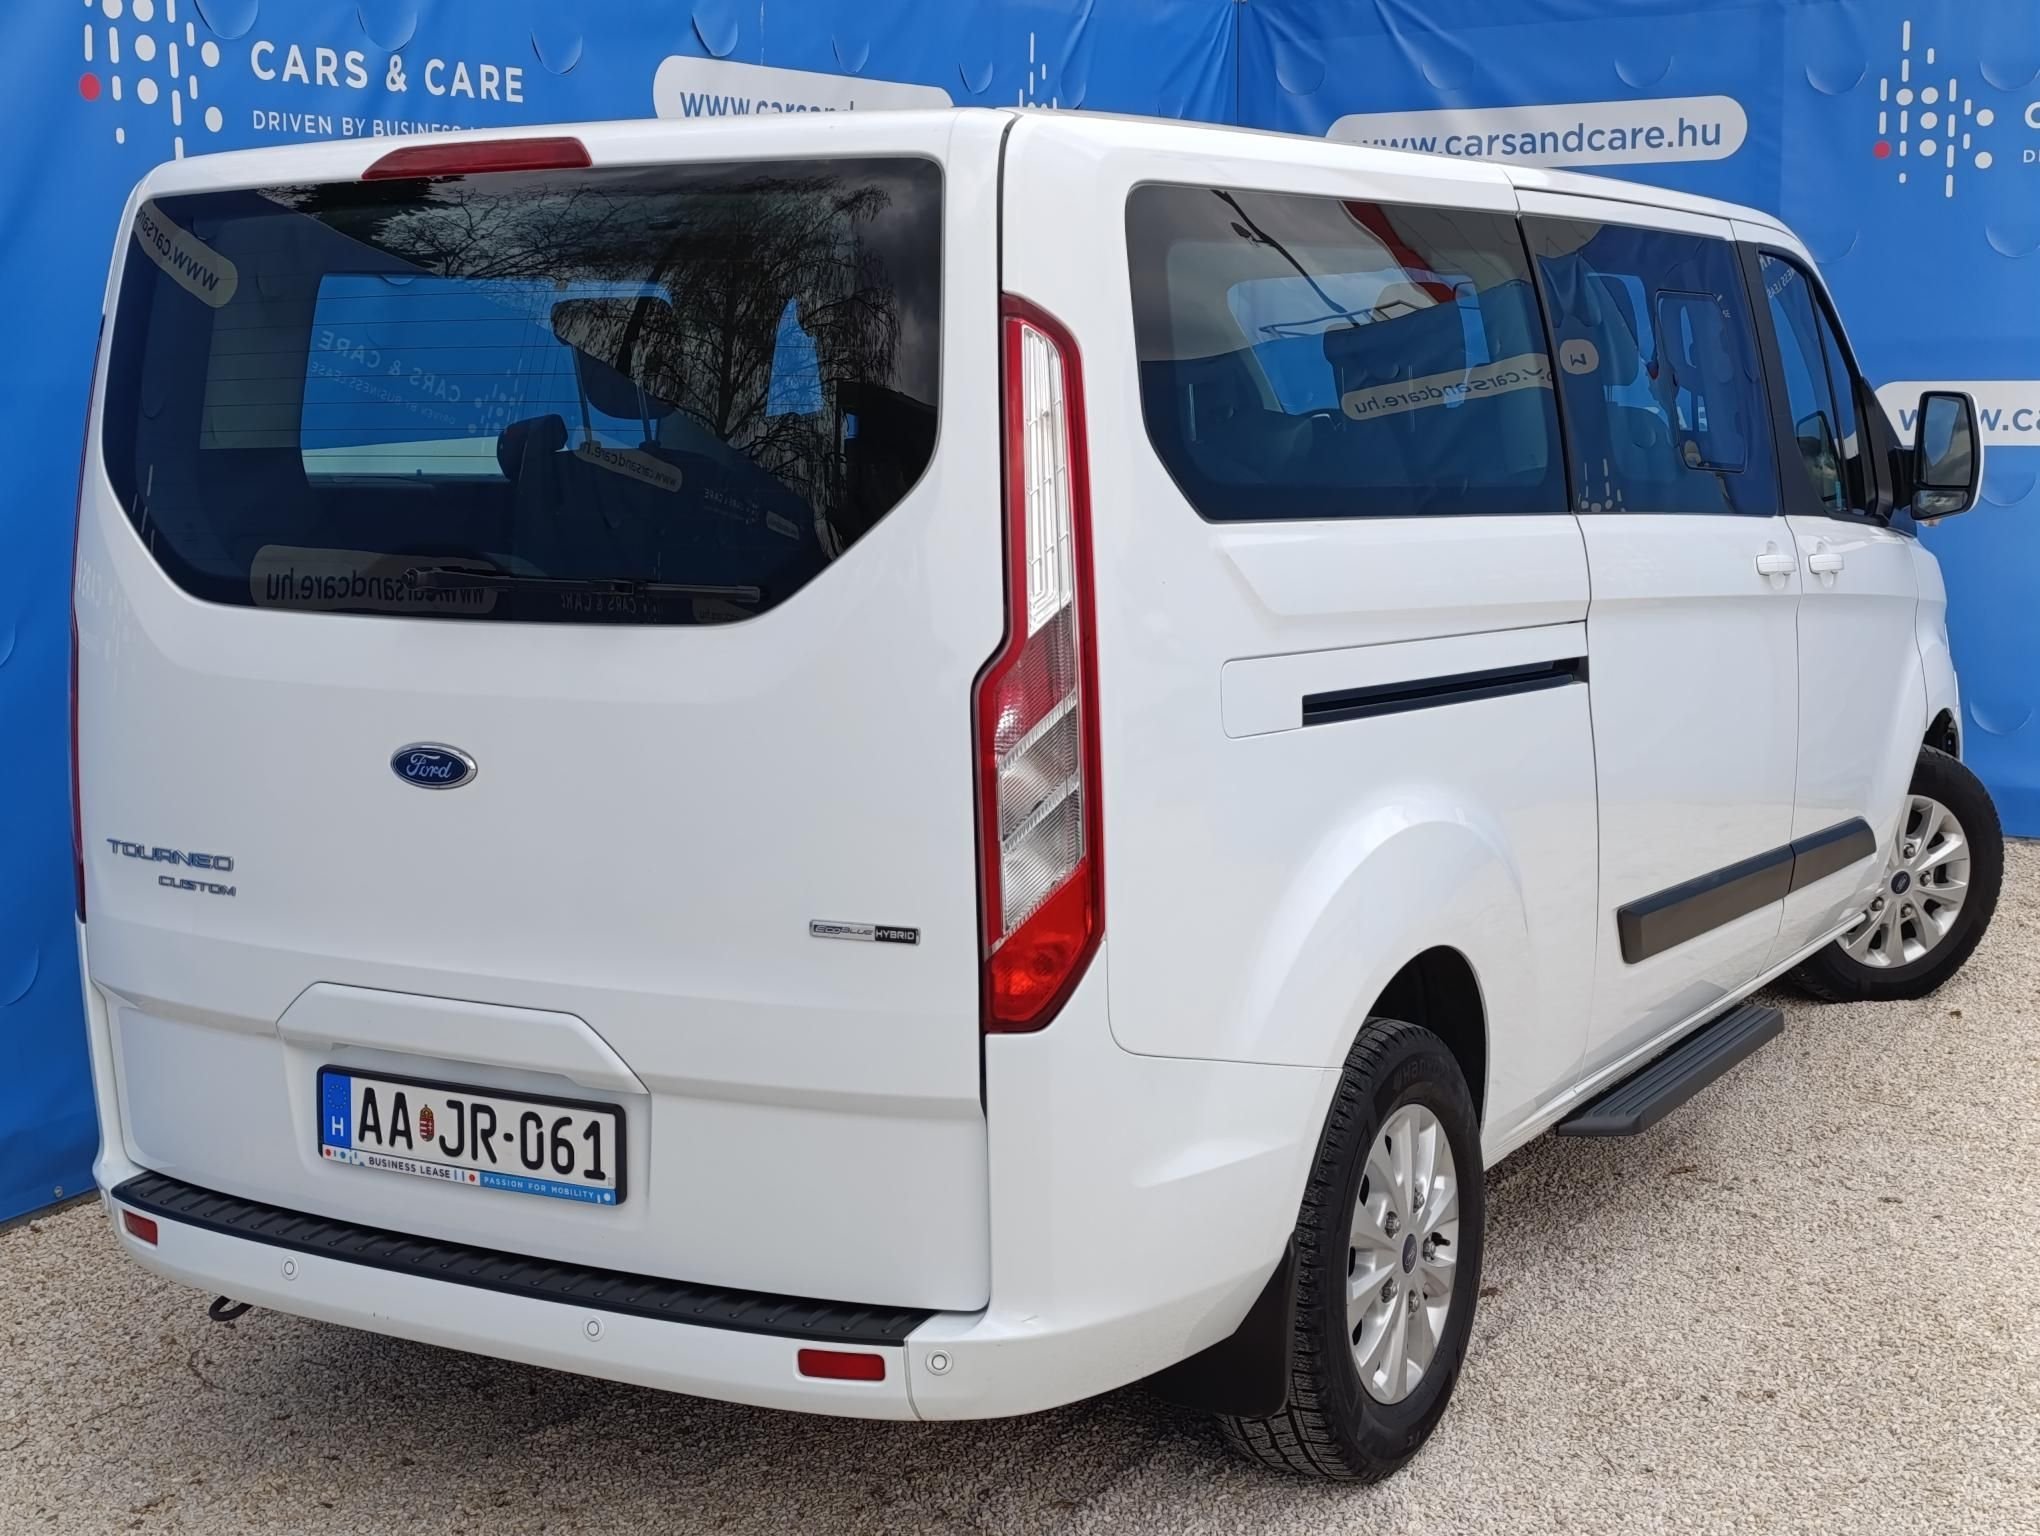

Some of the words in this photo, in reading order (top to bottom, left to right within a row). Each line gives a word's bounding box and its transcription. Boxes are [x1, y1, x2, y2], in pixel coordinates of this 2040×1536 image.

[250, 40, 369, 89] CARS
[385, 54, 408, 93] &
[423, 58, 524, 103] CARE
[252, 110, 333, 136] DRIVEN
[342, 117, 366, 137] BY
[1358, 116, 1722, 157] wcarsandcare.hu
[2023, 149, 2040, 163] D
[406, 753, 452, 778] Ford
[106, 838, 235, 872] TOURNEO
[158, 875, 237, 897] CUSTOM
[875, 928, 916, 941] HYBRID
[331, 1115, 344, 1137] H
[358, 1087, 413, 1150] AA
[438, 1099, 606, 1181] JR-061
[368, 1156, 416, 1174] BUSINESS
[419, 1164, 451, 1179] LEASE
[483, 1176, 524, 1189] PASSION
[528, 1182, 547, 1192] FOR
[551, 1186, 594, 1200] MOBILITY
